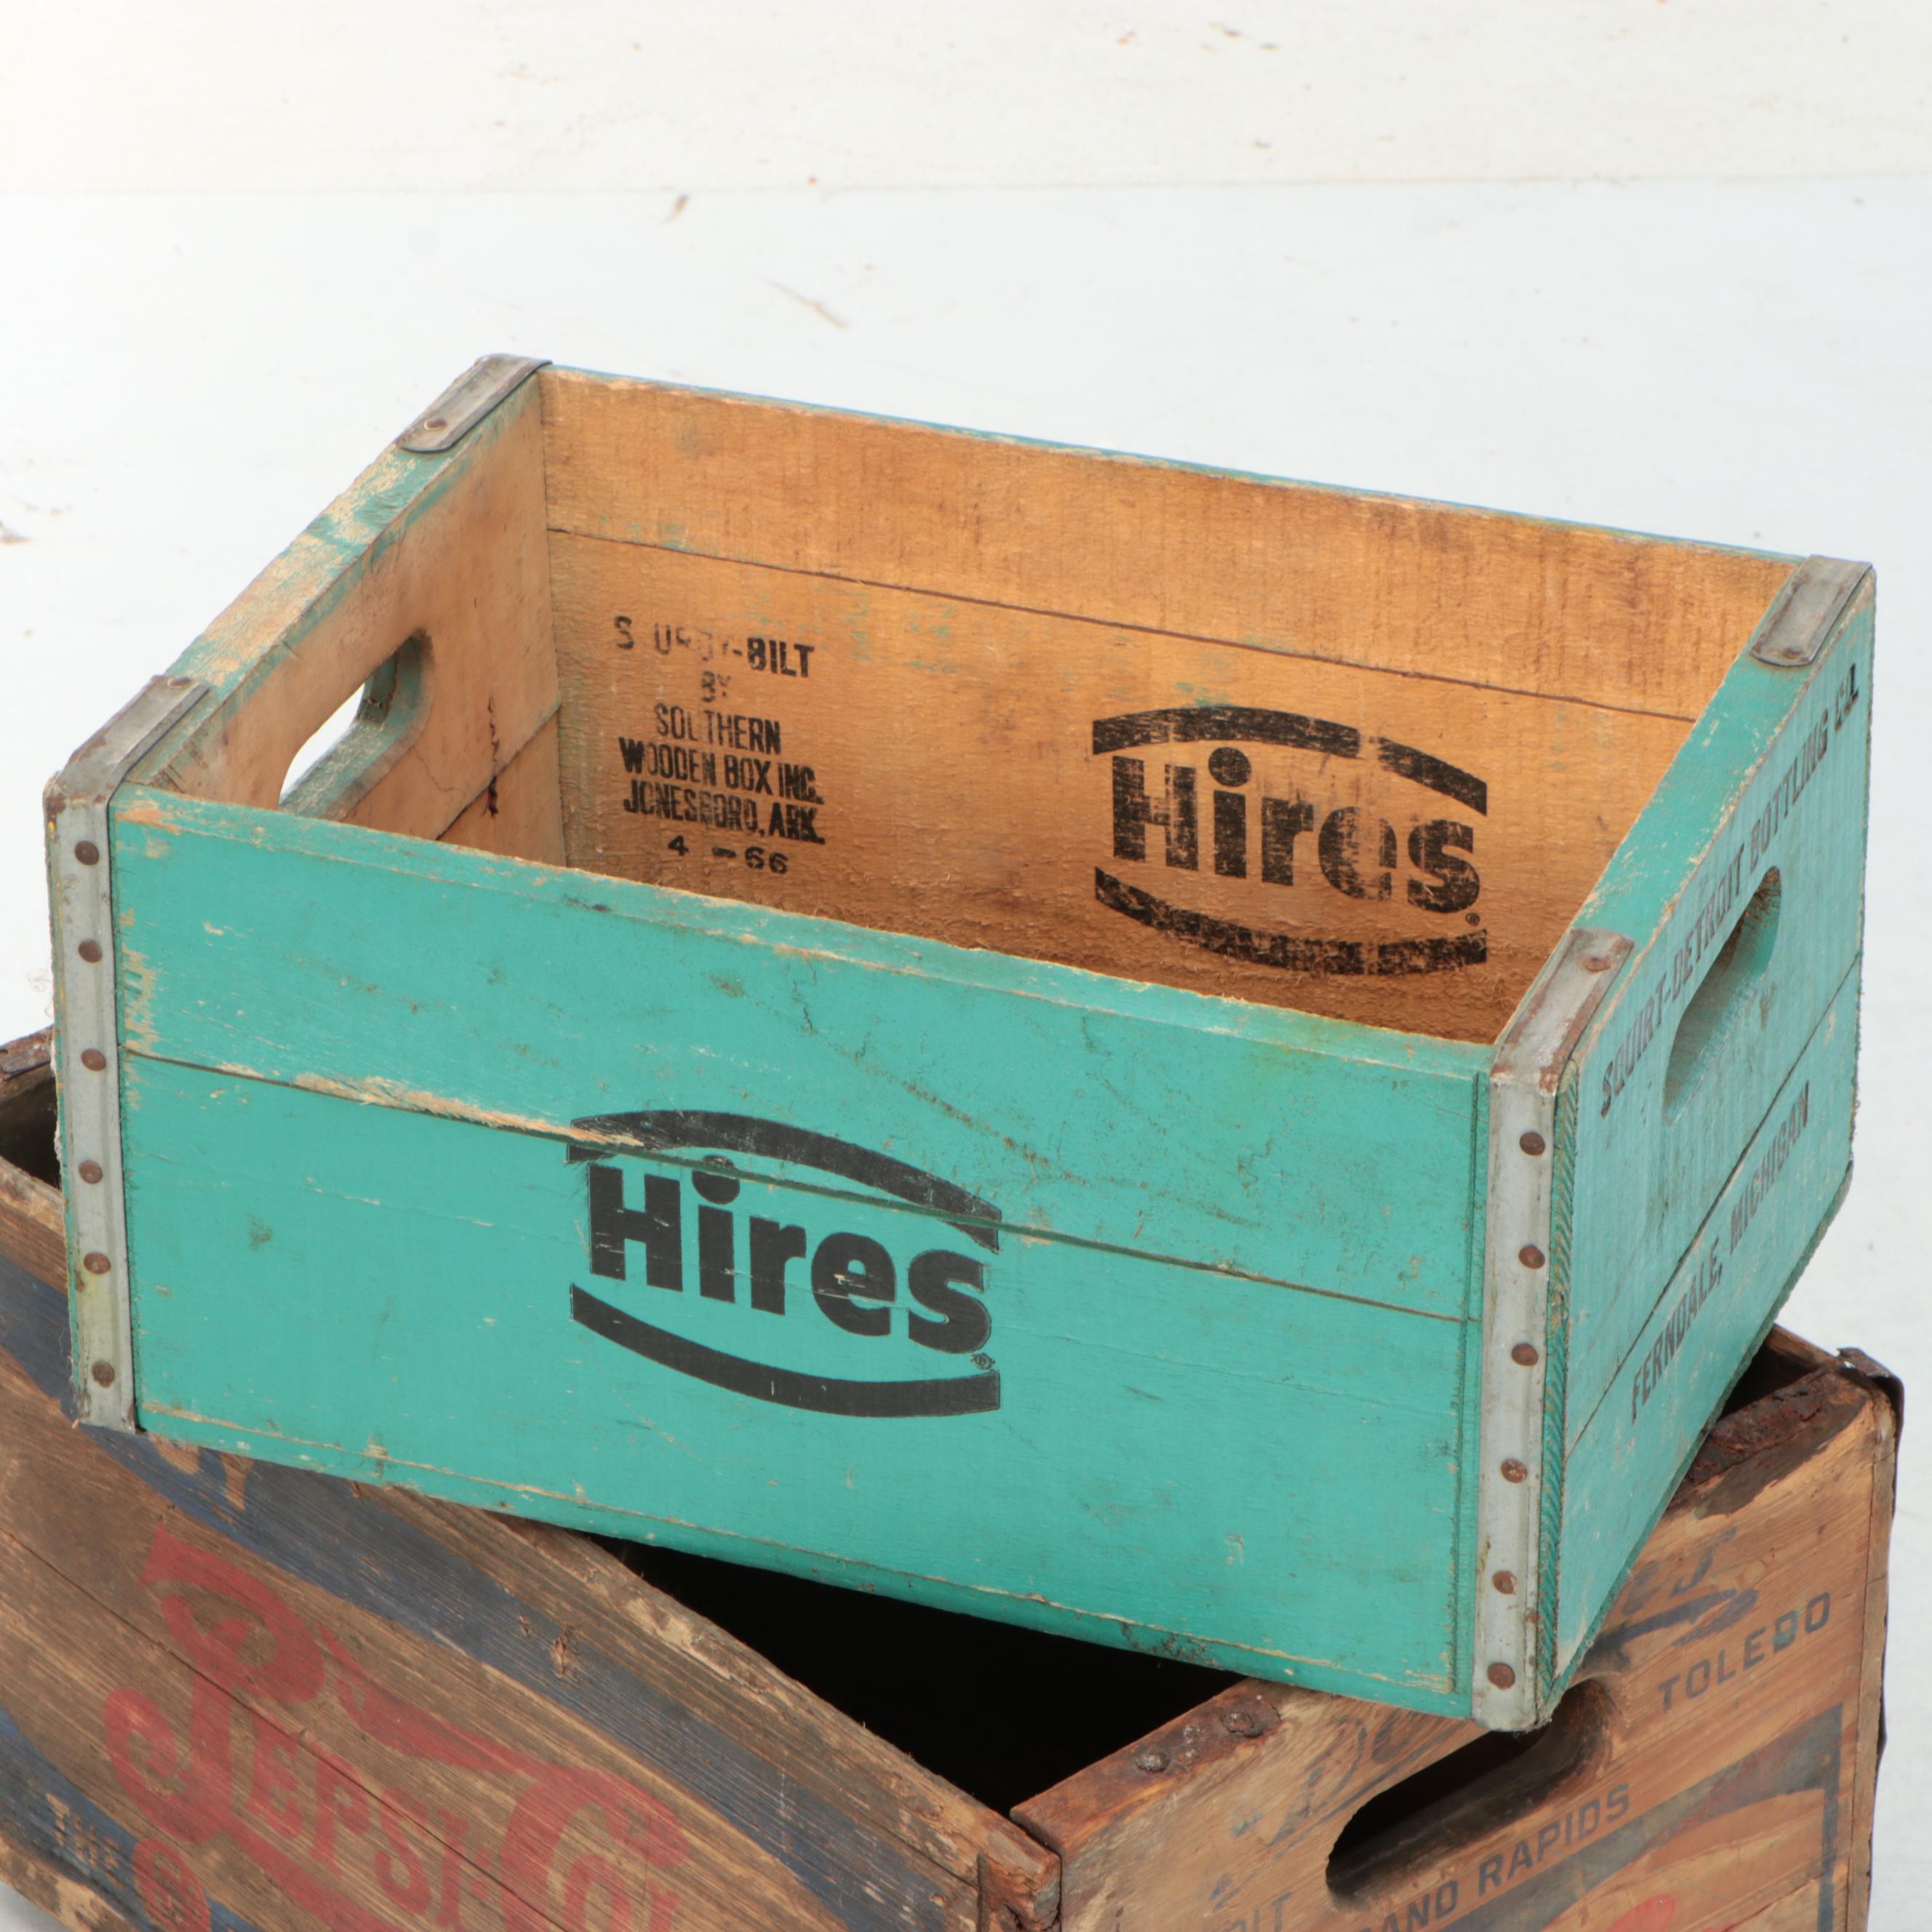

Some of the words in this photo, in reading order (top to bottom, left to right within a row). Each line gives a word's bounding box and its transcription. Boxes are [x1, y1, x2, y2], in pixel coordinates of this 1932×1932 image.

[618, 737, 717, 787] WOODEN
[724, 754, 773, 797] BOX
[1749, 708, 1829, 874] BOTTLING
[667, 835, 690, 857] 4
[1731, 1080, 1810, 1256] MICHIGAN
[588, 1155, 991, 1354] Hires
[1657, 1592, 1831, 1712] TOLEDO
[1478, 1783, 1631, 1896] RAPIDS
